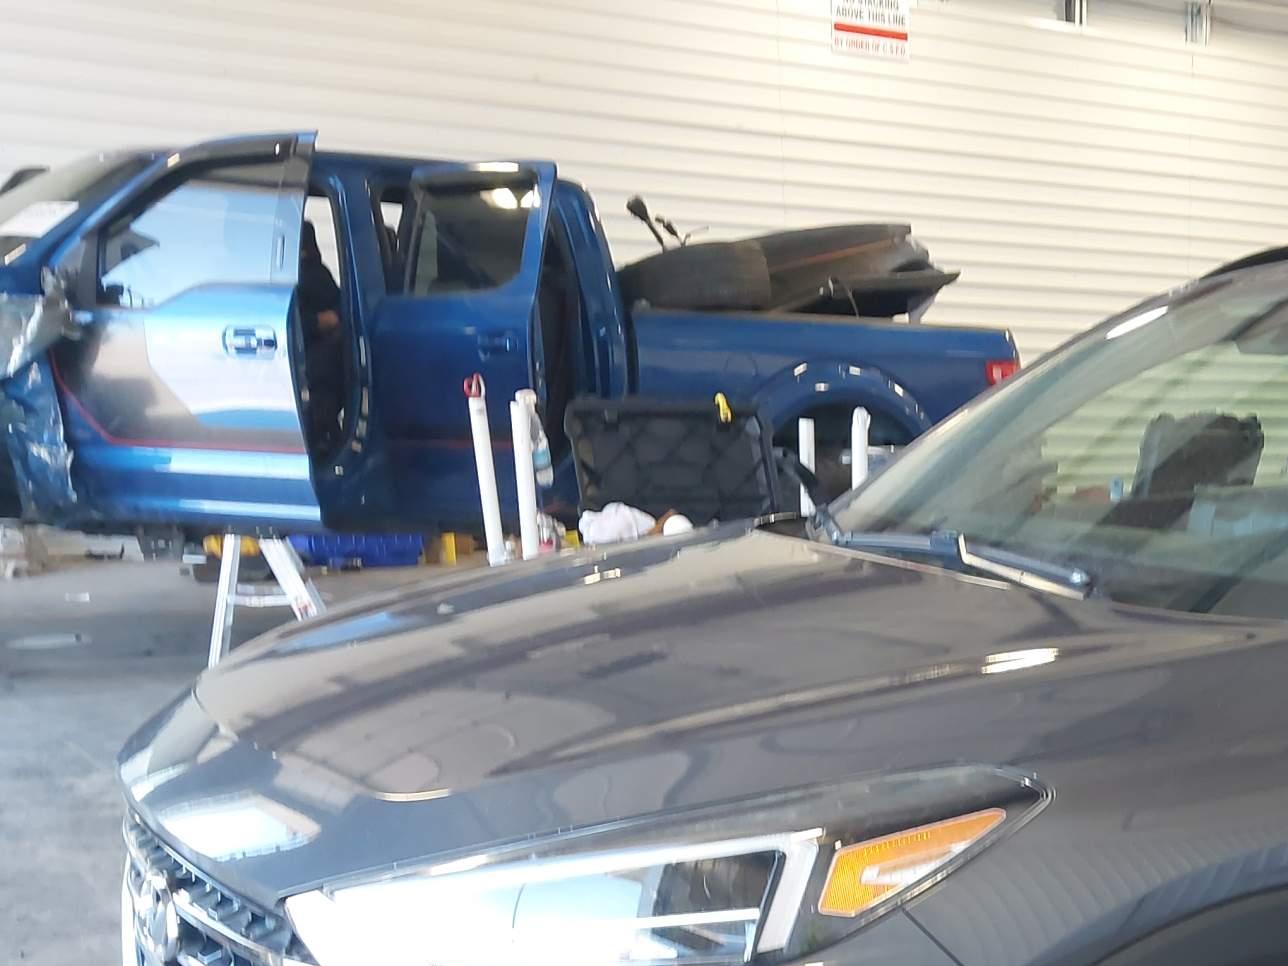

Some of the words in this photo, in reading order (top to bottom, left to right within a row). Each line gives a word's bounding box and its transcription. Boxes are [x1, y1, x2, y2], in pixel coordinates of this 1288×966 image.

[836, 5, 865, 20] ABOVE
[867, 9, 886, 24] THIS
[888, 13, 906, 27] LINE
